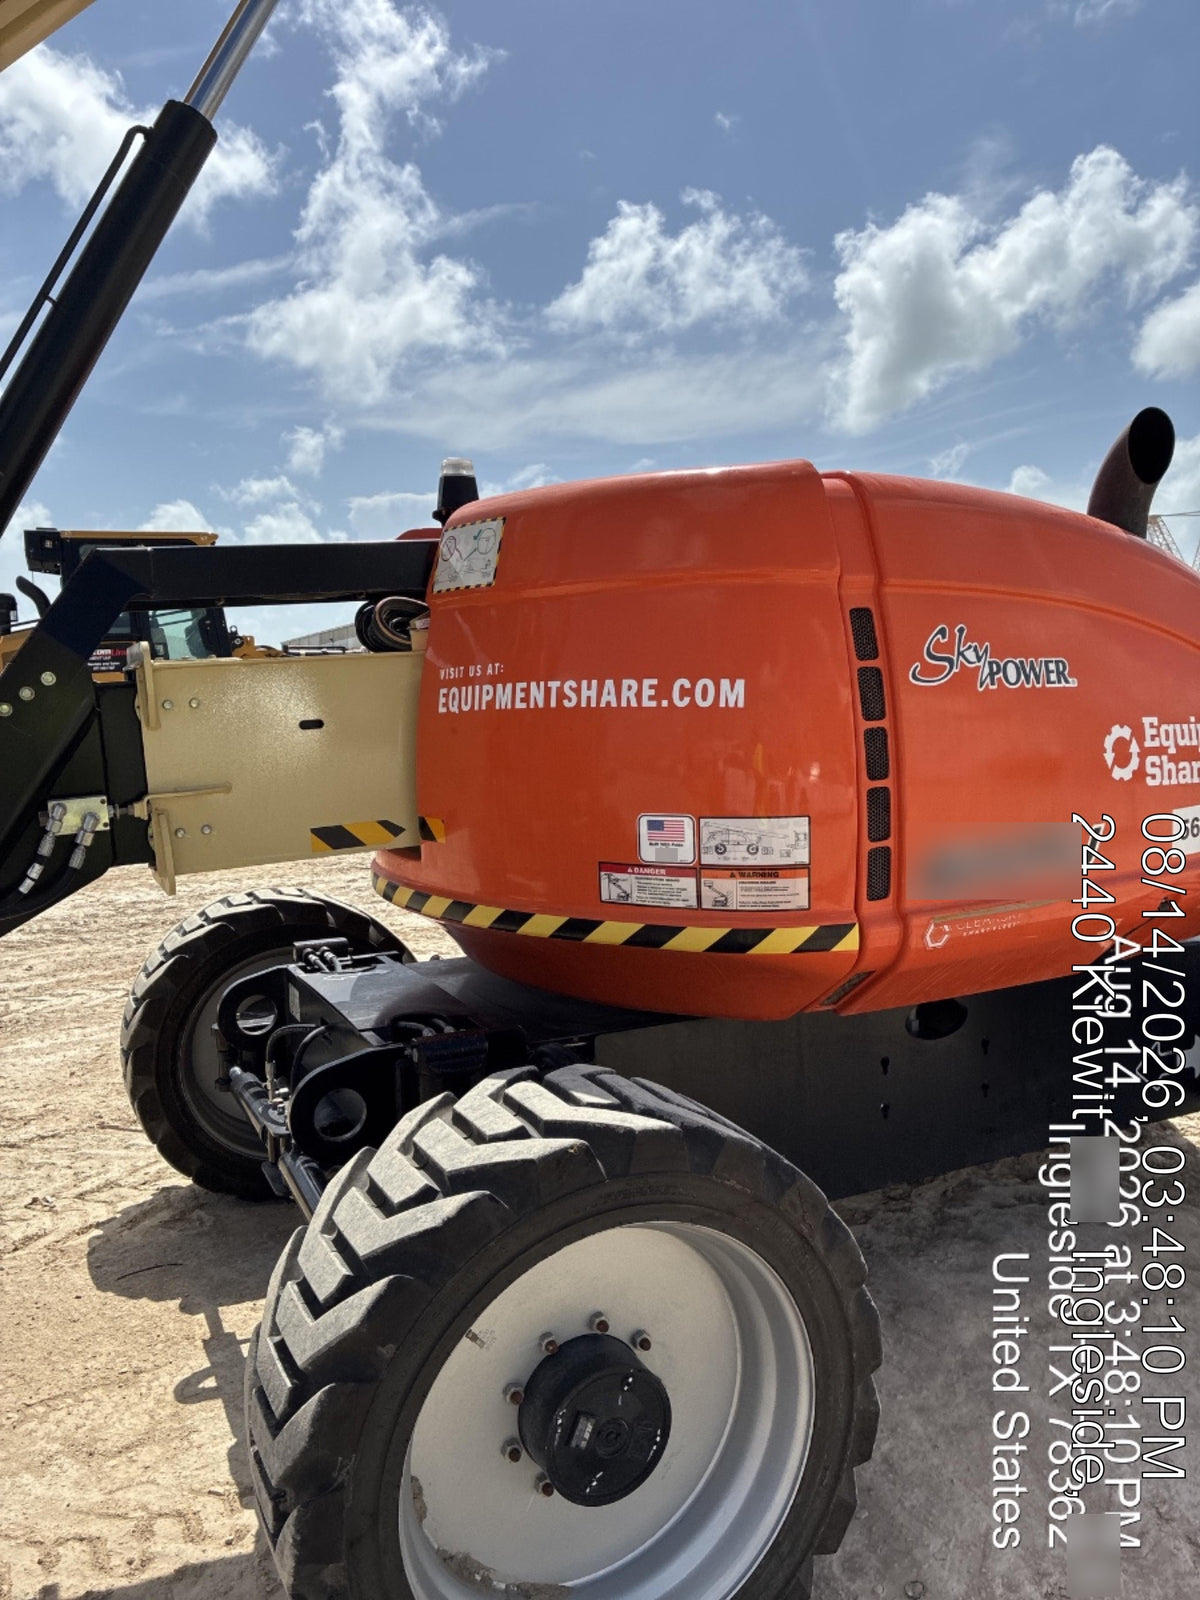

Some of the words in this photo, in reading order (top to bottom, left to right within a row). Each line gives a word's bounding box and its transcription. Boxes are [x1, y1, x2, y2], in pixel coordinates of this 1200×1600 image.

[440, 666, 464, 680] VISIT
[468, 664, 482, 677] US
[486, 662, 504, 676] AT:
[988, 658, 1071, 688] POWER
[438, 678, 746, 714] EQUIPMENTSHARE.COM
[634, 867, 667, 875] DANGER
